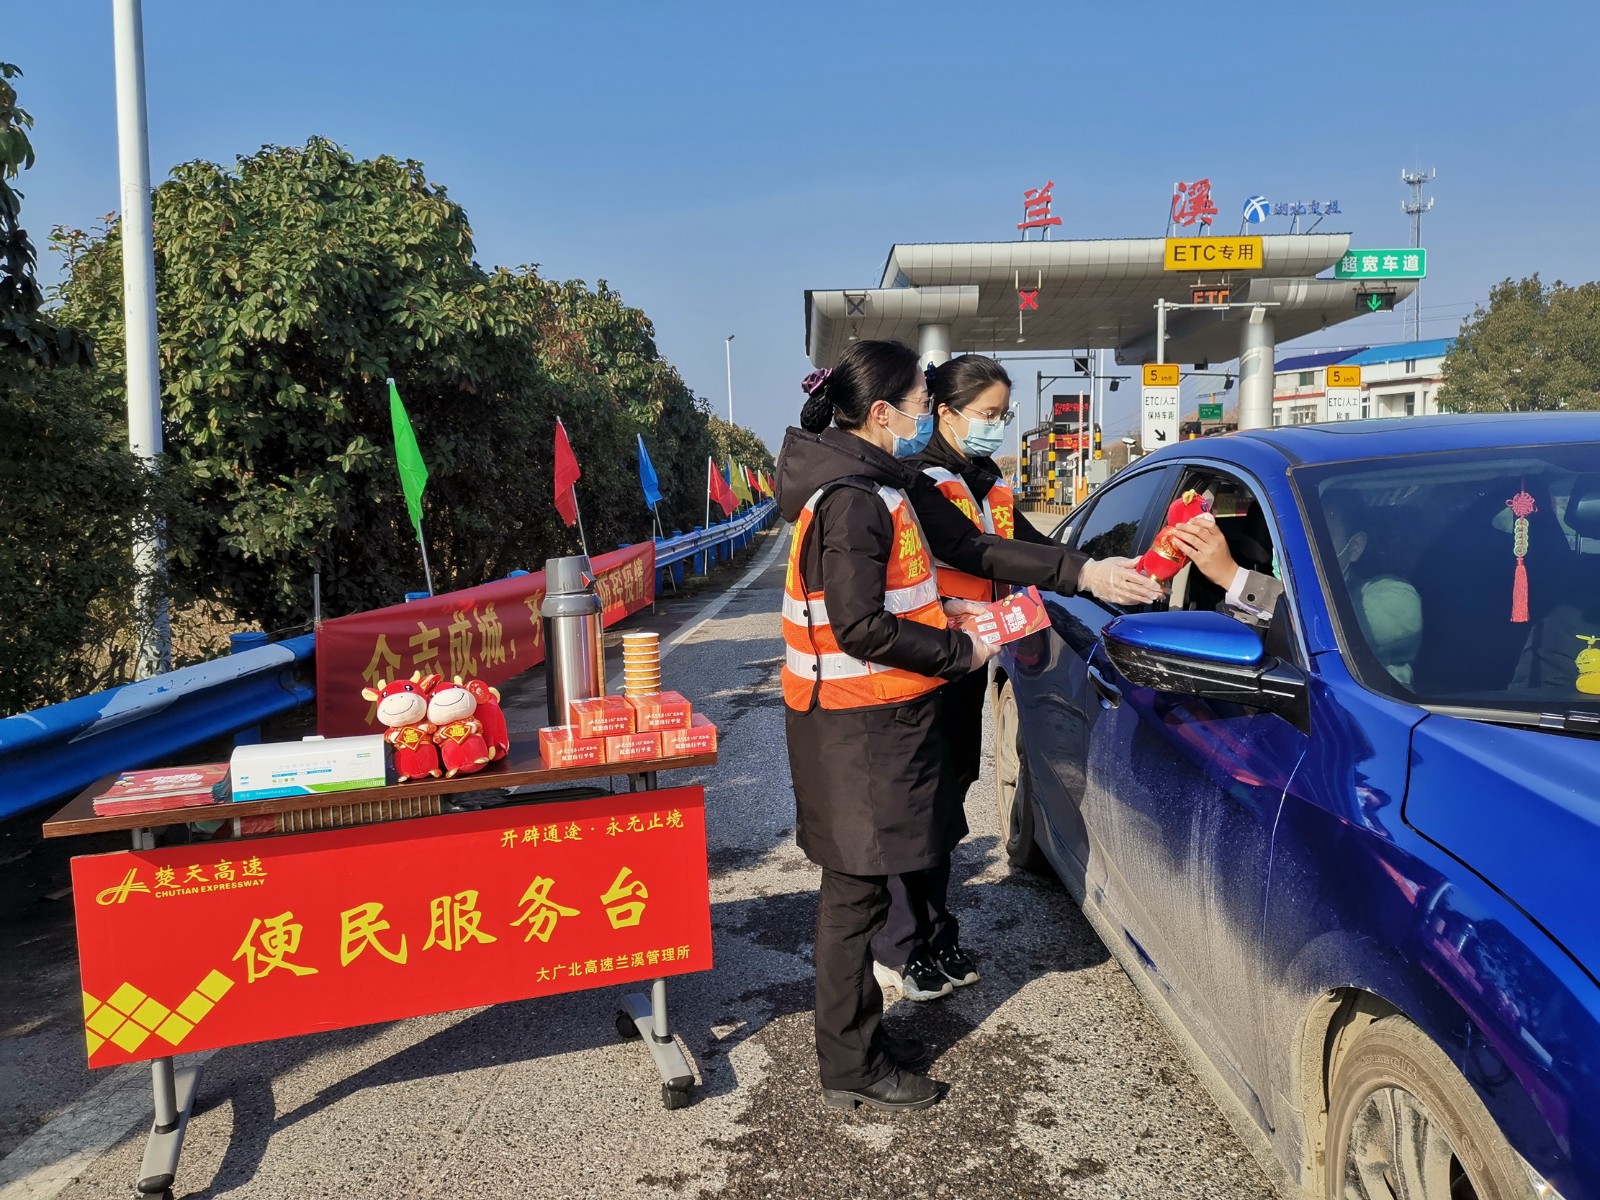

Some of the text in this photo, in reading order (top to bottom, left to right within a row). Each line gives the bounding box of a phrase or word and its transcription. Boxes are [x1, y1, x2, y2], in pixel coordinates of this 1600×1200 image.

[1017, 179, 1218, 230] 兰溪
[1173, 244, 1254, 262] ETC专用
[1341, 254, 1419, 272] 超宽车道
[1150, 370, 1158, 381] 5
[1333, 370, 1341, 382] 5
[1145, 396, 1176, 406] ETC/人工
[1328, 397, 1358, 407] ETC/人工
[992, 503, 1014, 529] 交
[154, 855, 268, 889] 楚天高速
[155, 878, 265, 899] CHUTIAN EXPRESSWAY
[232, 866, 650, 984] 便民服务台
[536, 945, 691, 983] 大广北高速兰溪管理所
